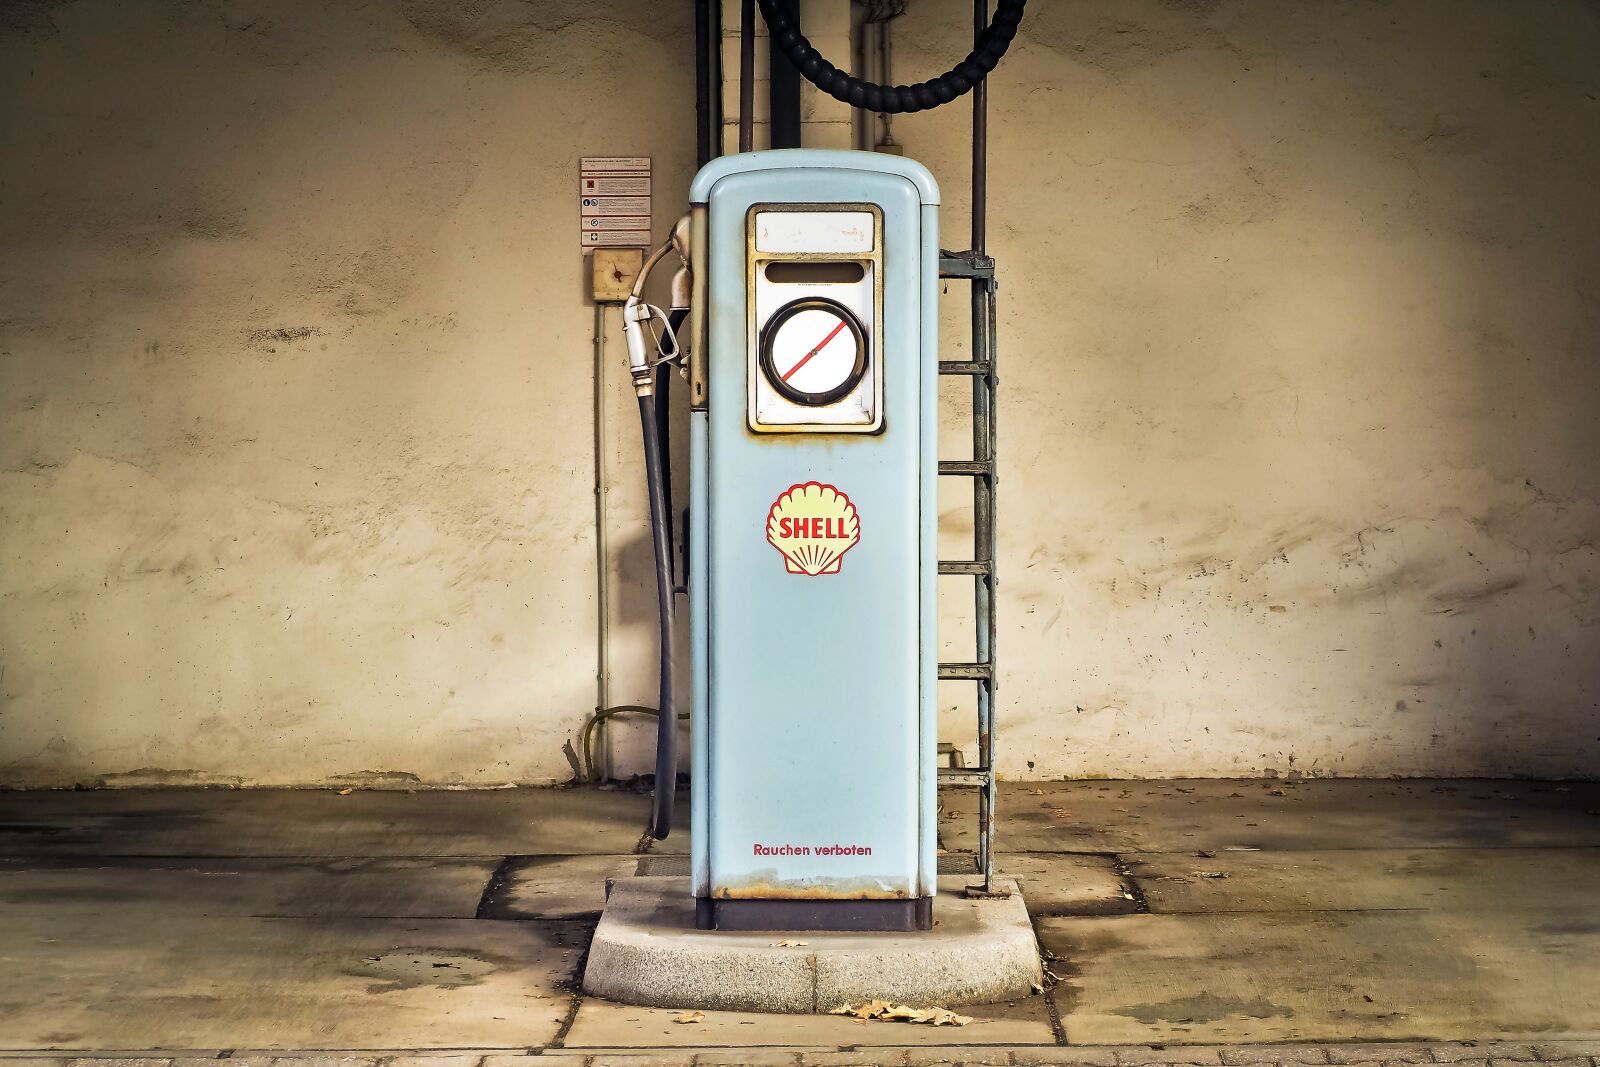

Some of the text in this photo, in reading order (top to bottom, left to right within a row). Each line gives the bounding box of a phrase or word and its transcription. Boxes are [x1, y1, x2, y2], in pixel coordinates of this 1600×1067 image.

[779, 517, 850, 539] SHELL
[753, 843, 872, 856] Rauchen verboten
